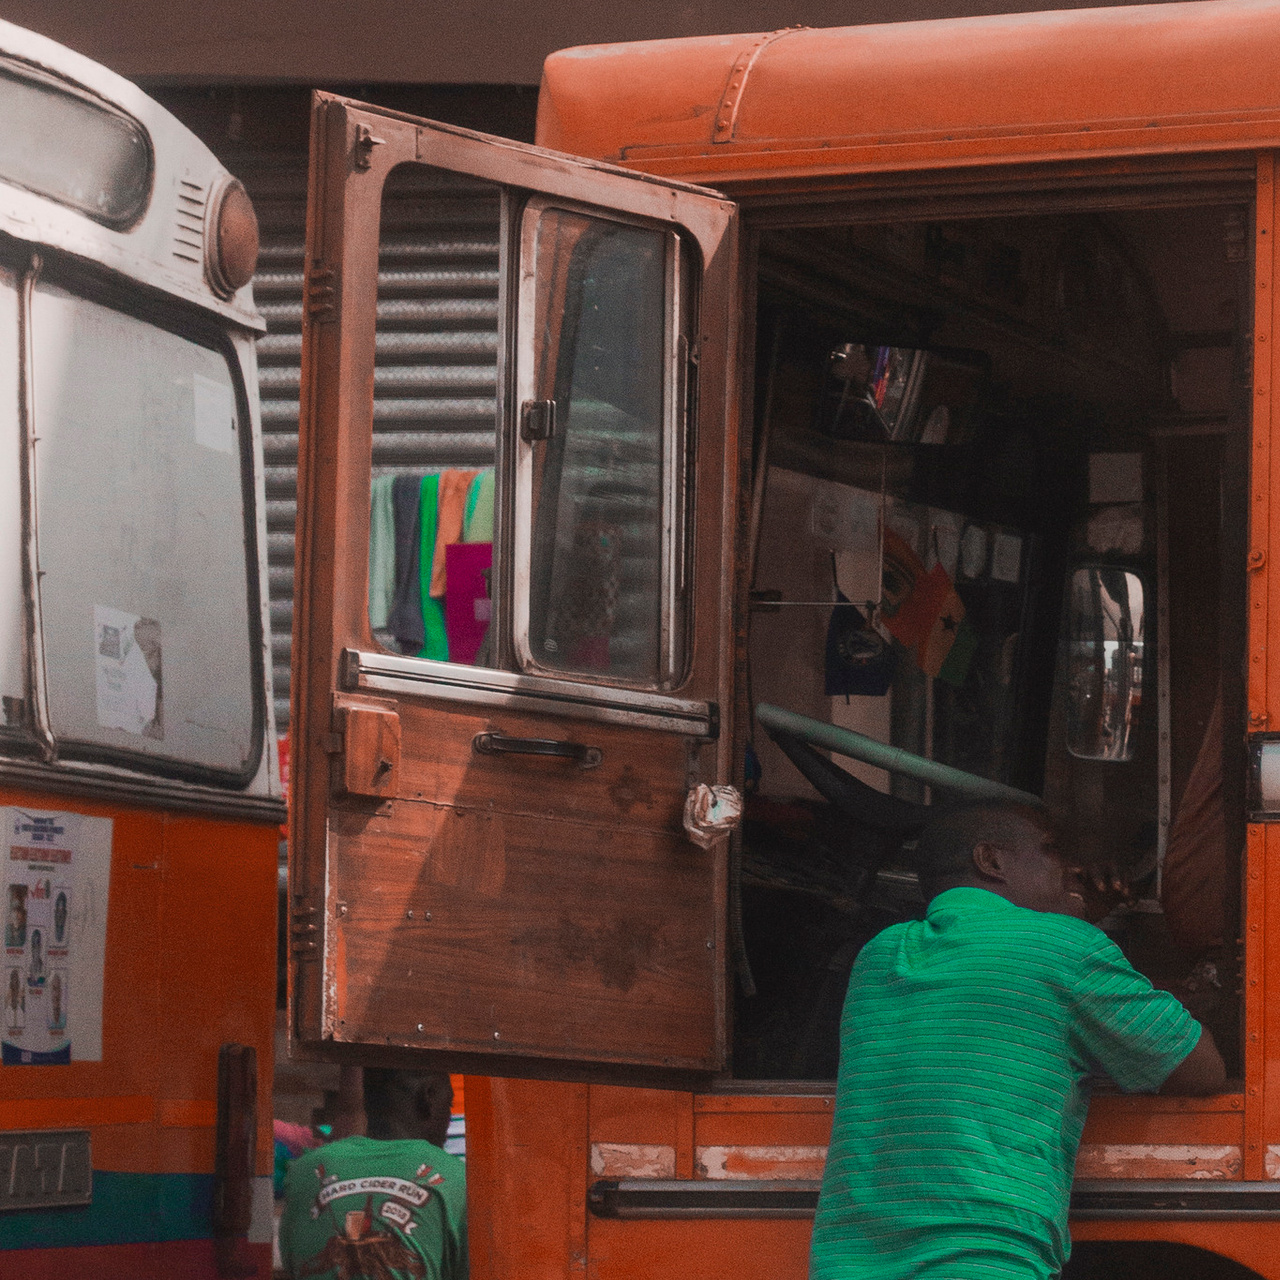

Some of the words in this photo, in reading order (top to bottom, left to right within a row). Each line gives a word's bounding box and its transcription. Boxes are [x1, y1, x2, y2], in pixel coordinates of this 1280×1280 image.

[322, 1182, 356, 1199] HARD
[360, 1179, 397, 1190] CIDER
[398, 1184, 424, 1200] RUN
